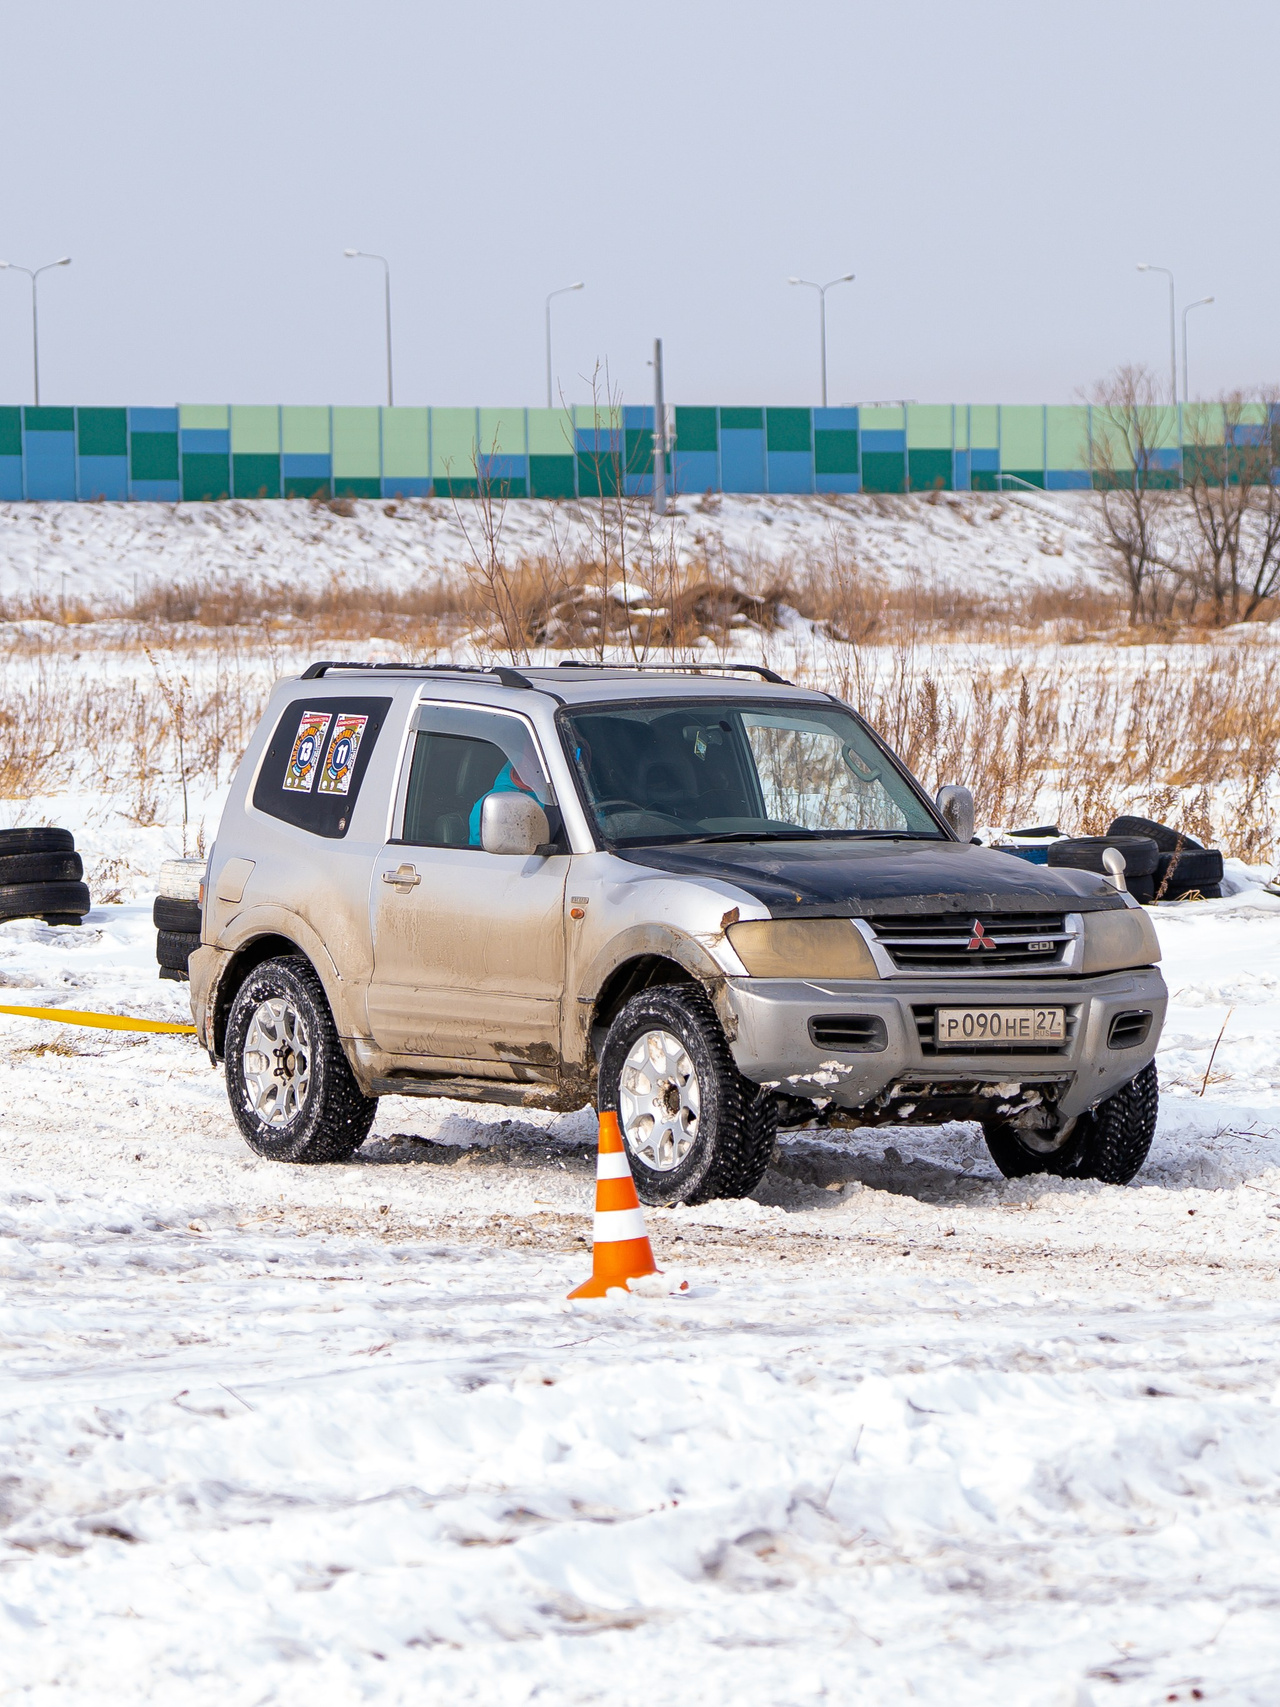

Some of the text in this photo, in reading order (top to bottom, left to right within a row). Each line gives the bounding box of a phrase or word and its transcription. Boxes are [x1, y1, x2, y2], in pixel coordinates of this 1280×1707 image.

[299, 741, 313, 762] 13
[336, 744, 348, 764] 11
[1028, 941, 1054, 951] GDI
[1036, 1011, 1057, 1030] 27
[1035, 1029, 1050, 1037] RUS
